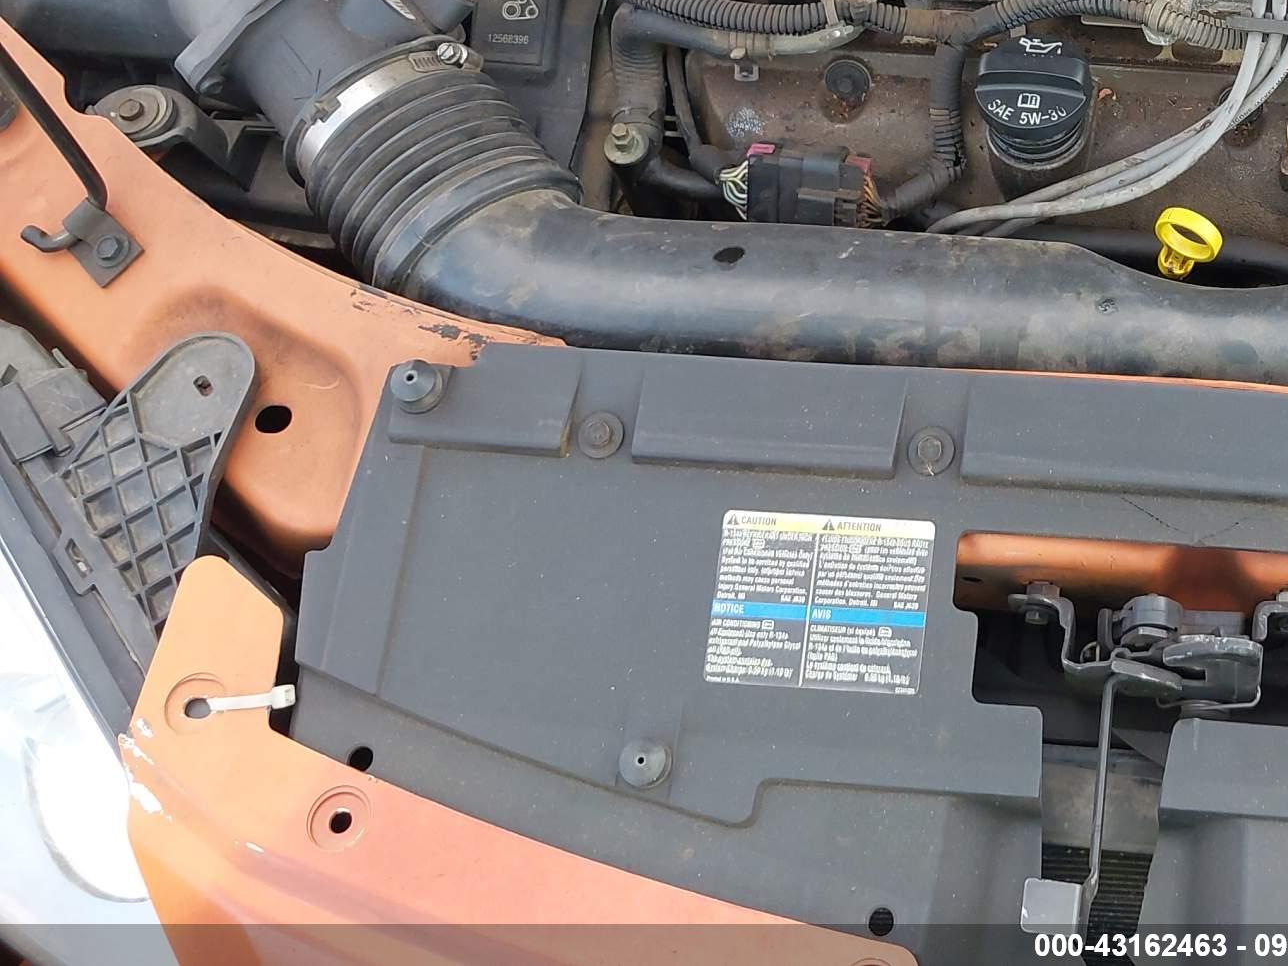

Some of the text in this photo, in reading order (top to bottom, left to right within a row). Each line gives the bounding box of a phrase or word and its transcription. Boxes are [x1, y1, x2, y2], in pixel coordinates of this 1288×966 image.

[987, 99, 1067, 125] SAE 5W-30
[741, 515, 776, 525] CAUTION
[836, 521, 881, 531] ATTENTION
[713, 602, 745, 614] NOTICE
[812, 608, 831, 619] AVIS
